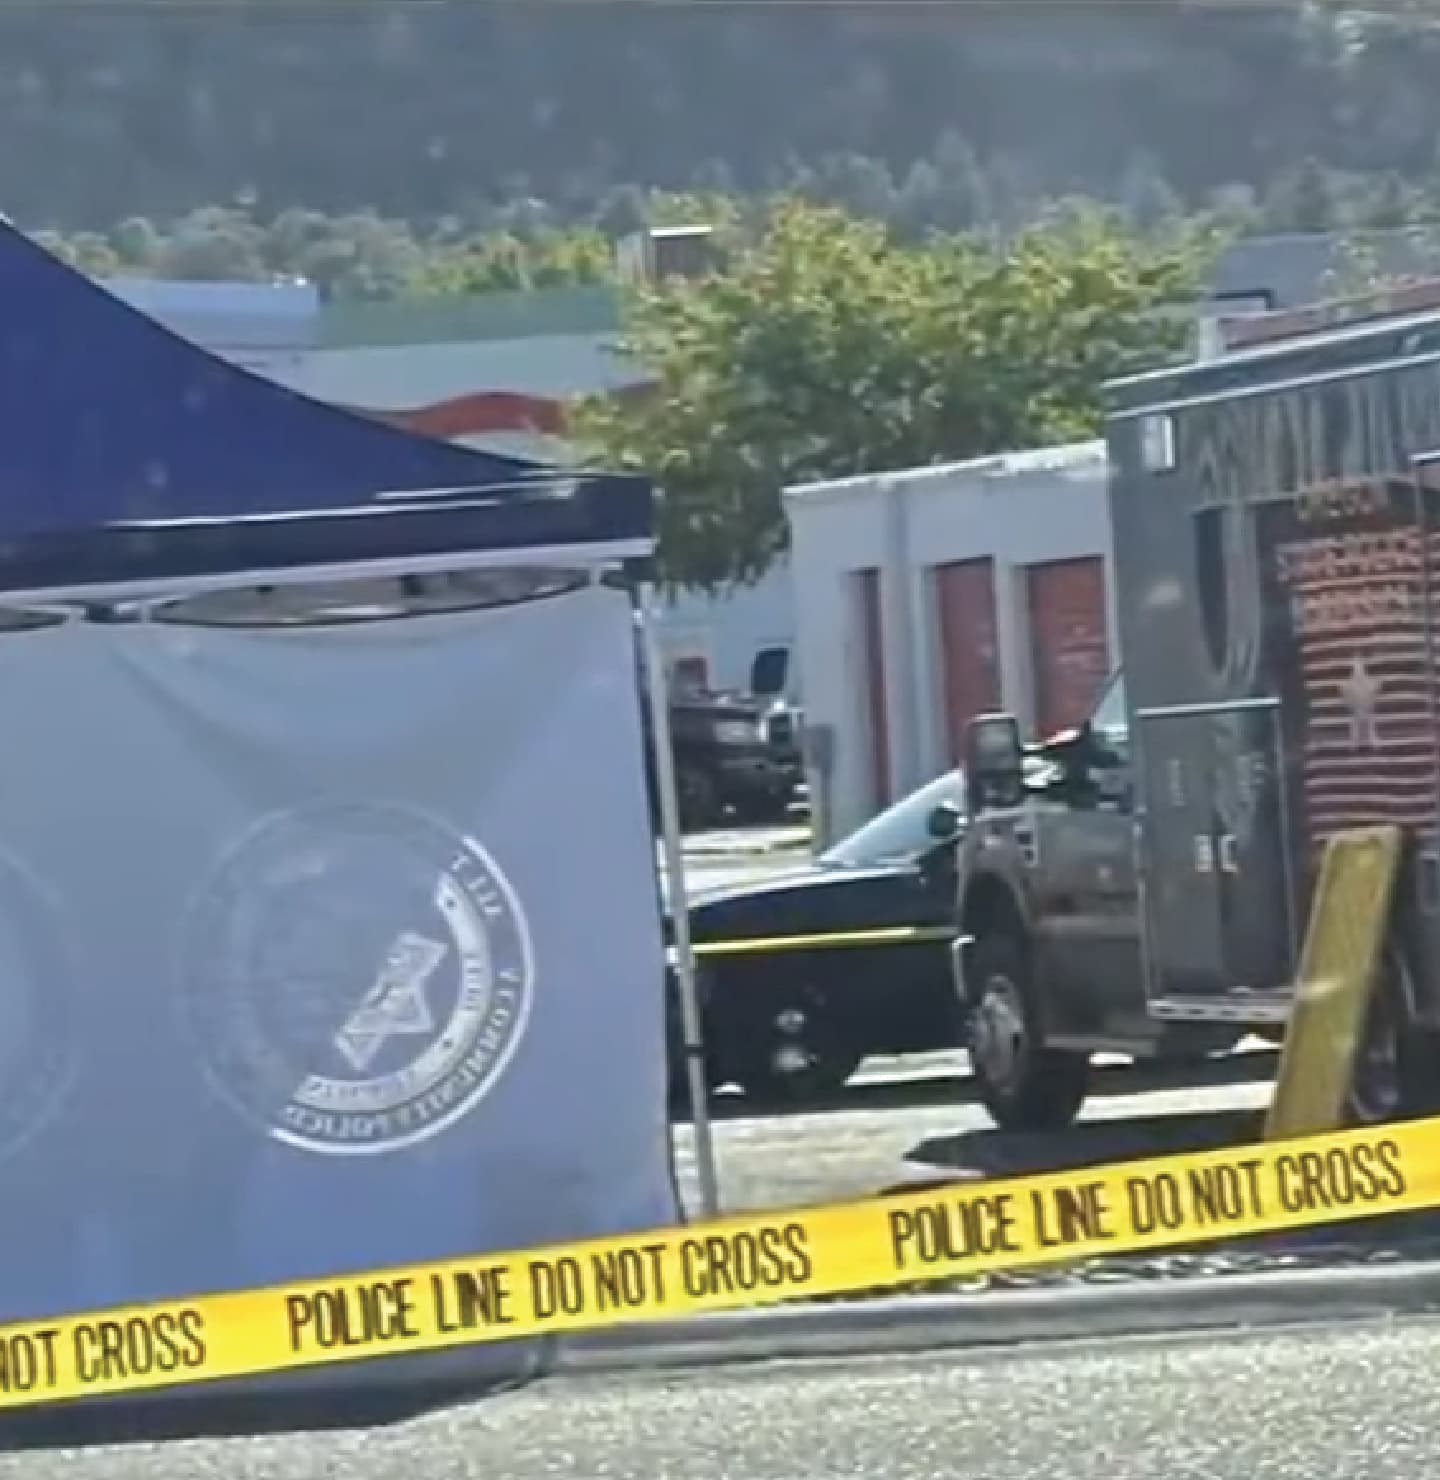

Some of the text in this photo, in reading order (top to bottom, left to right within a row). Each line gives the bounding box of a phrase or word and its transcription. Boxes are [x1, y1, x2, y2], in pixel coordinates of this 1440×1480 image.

[889, 1140, 1406, 1269] POLICE LINE DO NOT CROSS
[74, 1309, 205, 1383] CROSS
[286, 1223, 812, 1351] POLICE LINE DO NOT CROSS
